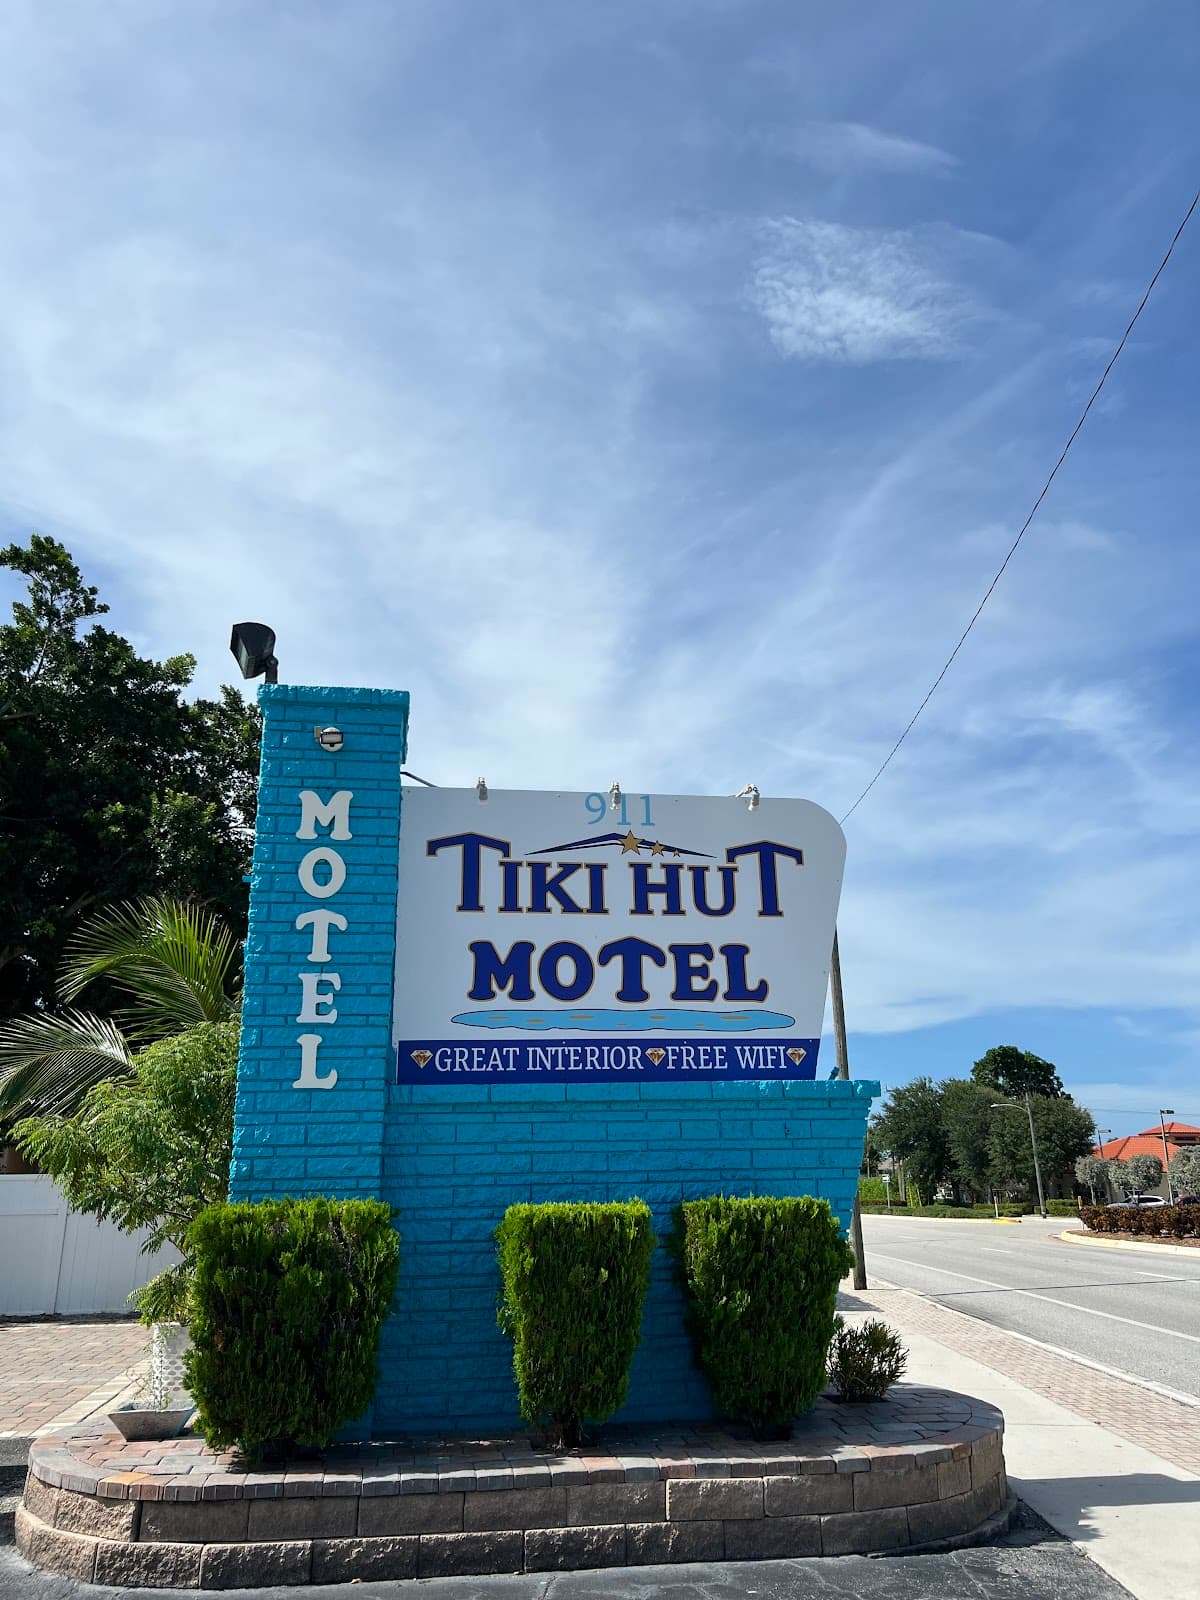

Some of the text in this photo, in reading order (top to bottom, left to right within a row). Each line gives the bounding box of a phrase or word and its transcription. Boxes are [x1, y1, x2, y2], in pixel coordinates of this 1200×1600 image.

[585, 792, 655, 826] 911
[426, 832, 804, 917] TIKI HUT
[293, 790, 353, 1089] MOTEL
[467, 936, 769, 1003] MOTEL
[434, 1046, 787, 1072] GREAT INTERIOR FREE WIFI
